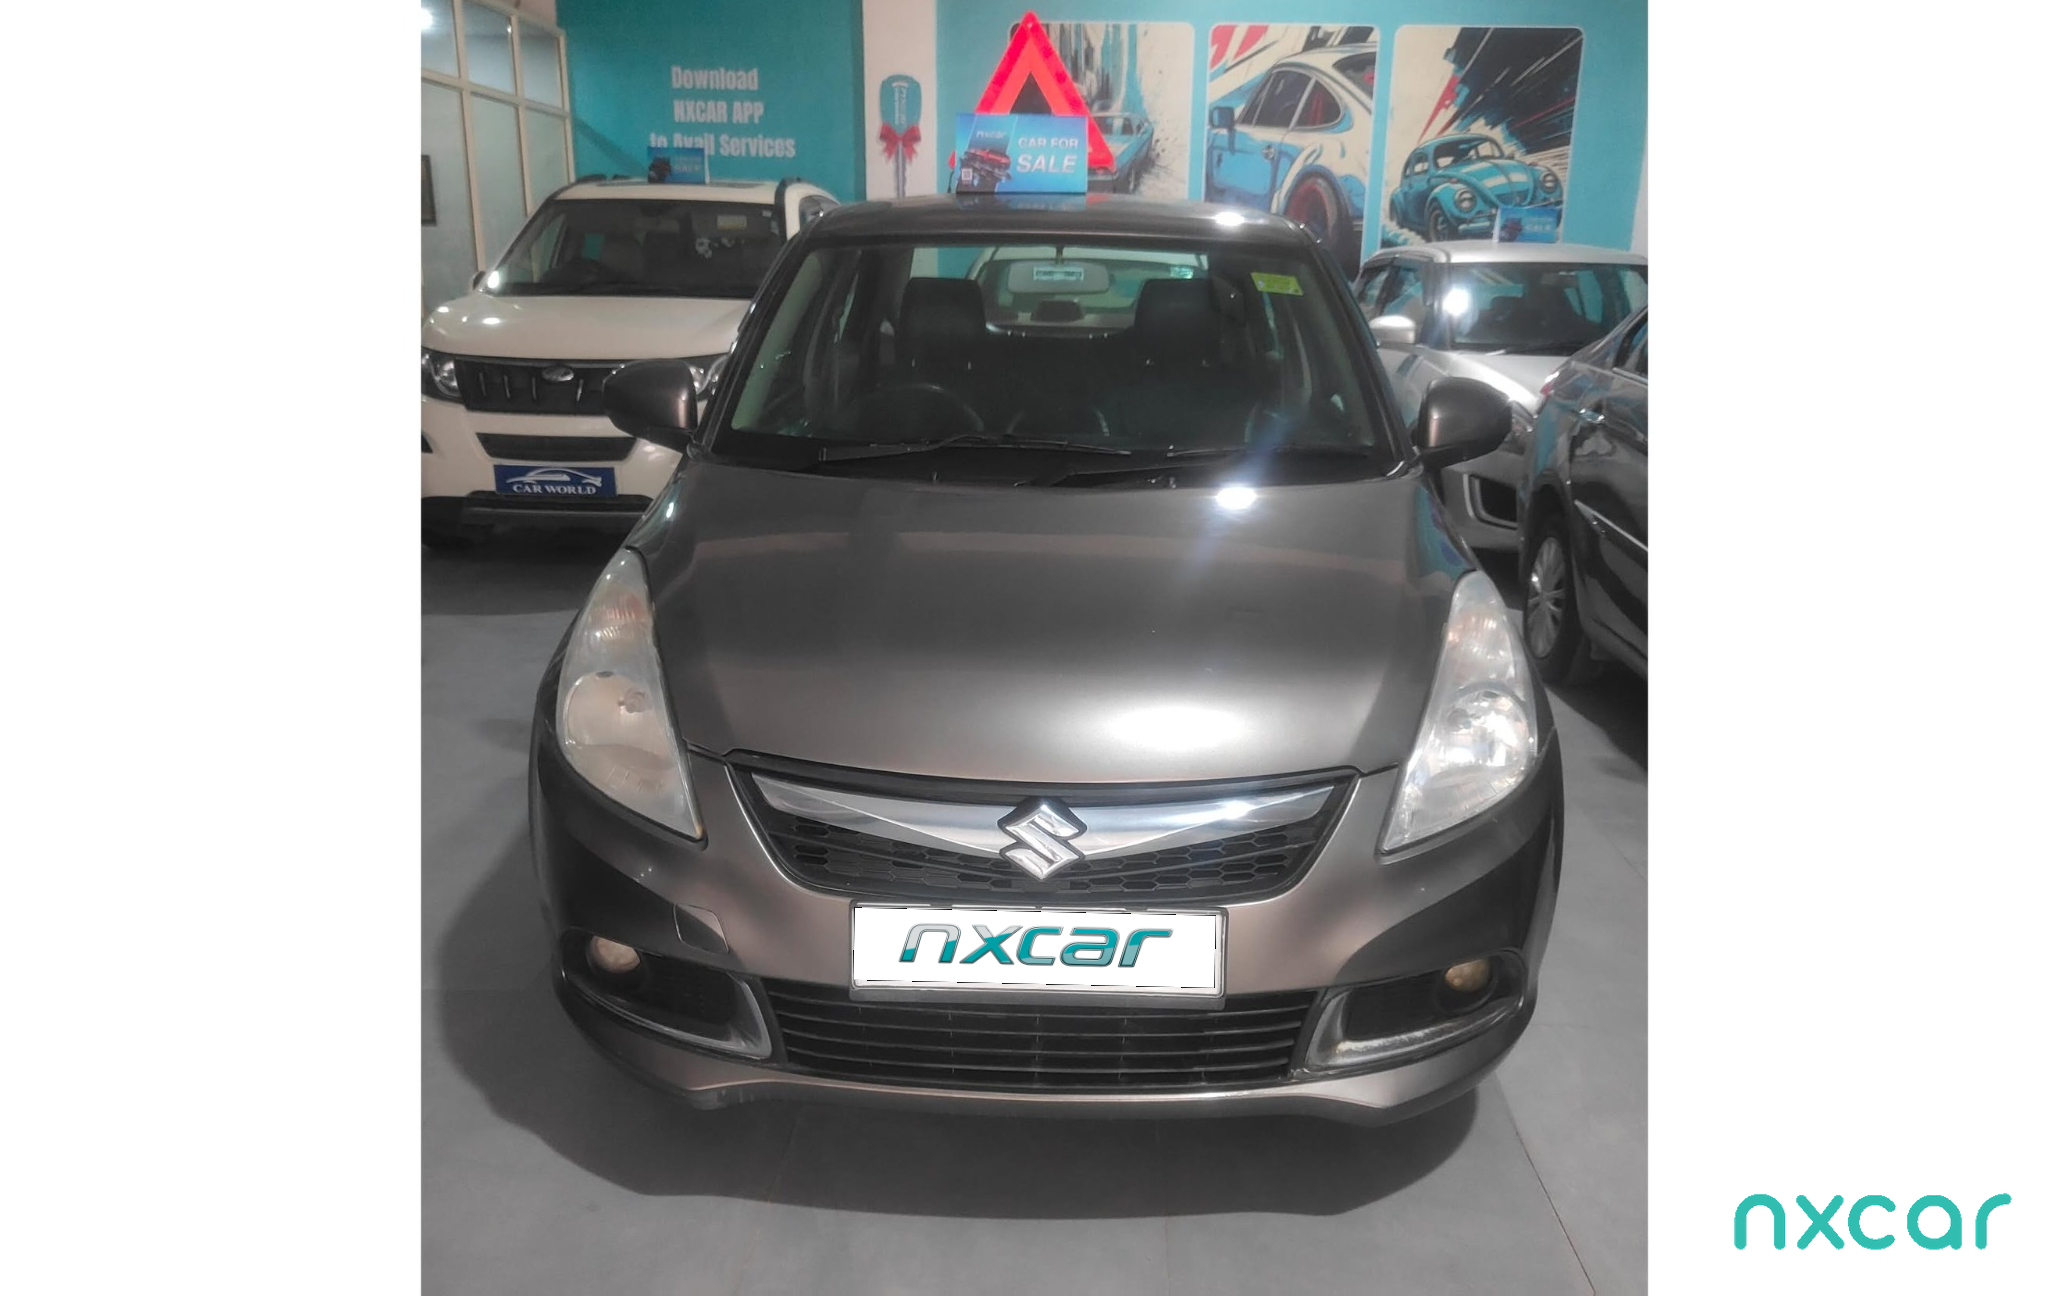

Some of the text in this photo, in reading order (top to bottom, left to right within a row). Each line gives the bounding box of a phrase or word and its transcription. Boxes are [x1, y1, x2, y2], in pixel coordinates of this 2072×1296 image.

[671, 65, 759, 91] Download
[673, 99, 764, 124] NXCAR APP
[719, 133, 796, 158] Services
[1018, 137, 1079, 150] CAR FOR
[1016, 154, 1077, 173] SALE
[512, 484, 597, 495] CAR WORLD
